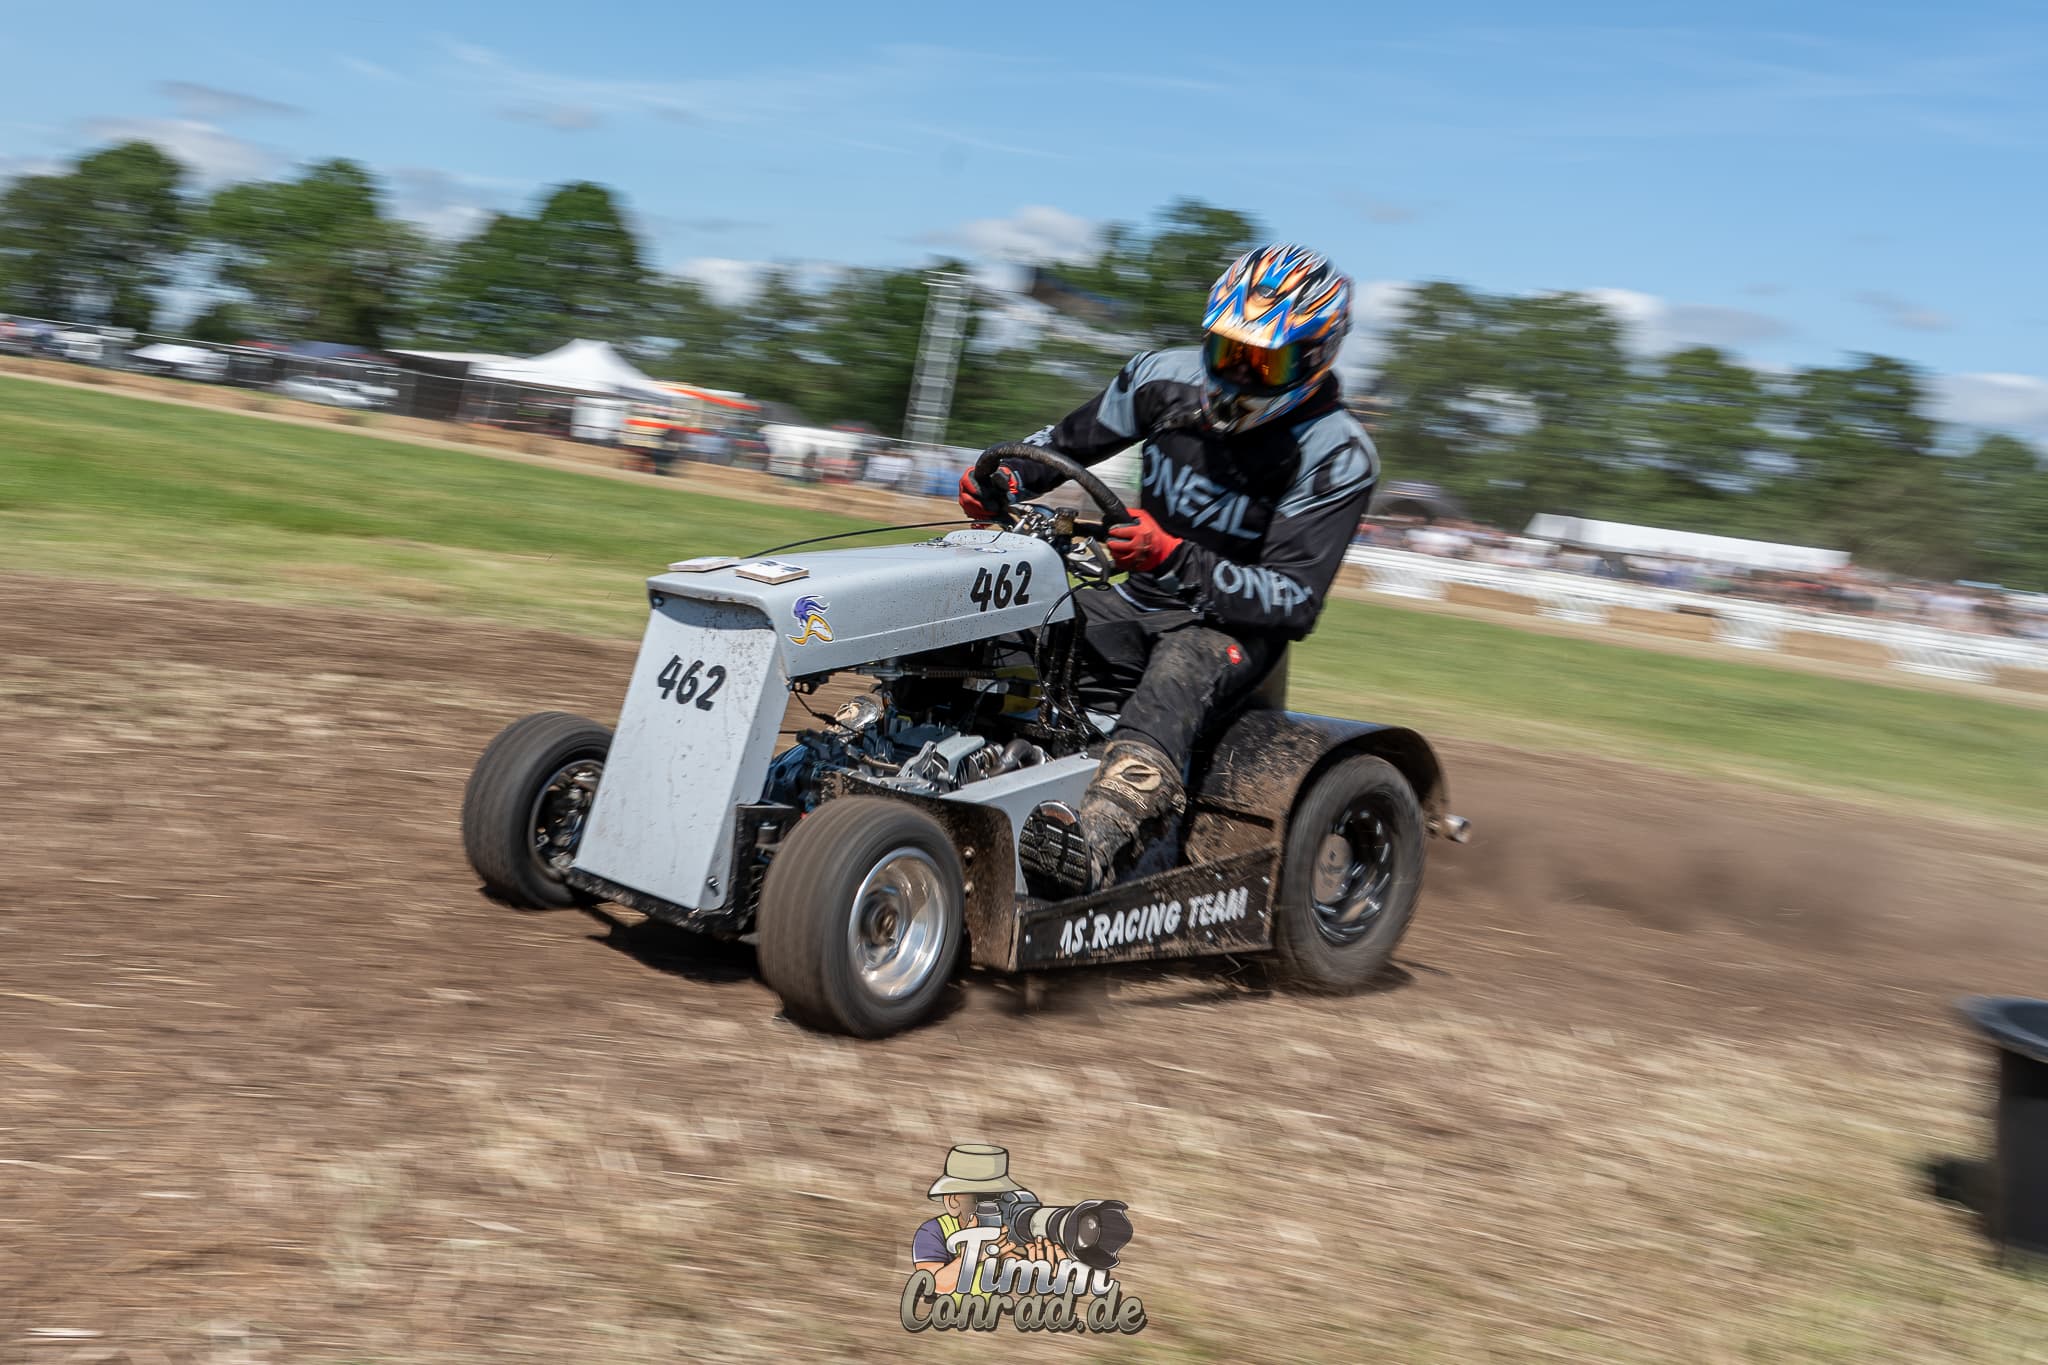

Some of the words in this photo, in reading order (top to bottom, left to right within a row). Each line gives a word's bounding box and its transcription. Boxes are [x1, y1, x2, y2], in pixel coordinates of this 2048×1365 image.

[970, 561, 1032, 612] 462
[657, 655, 727, 712] 462
[1188, 886, 1249, 928] TEAM
